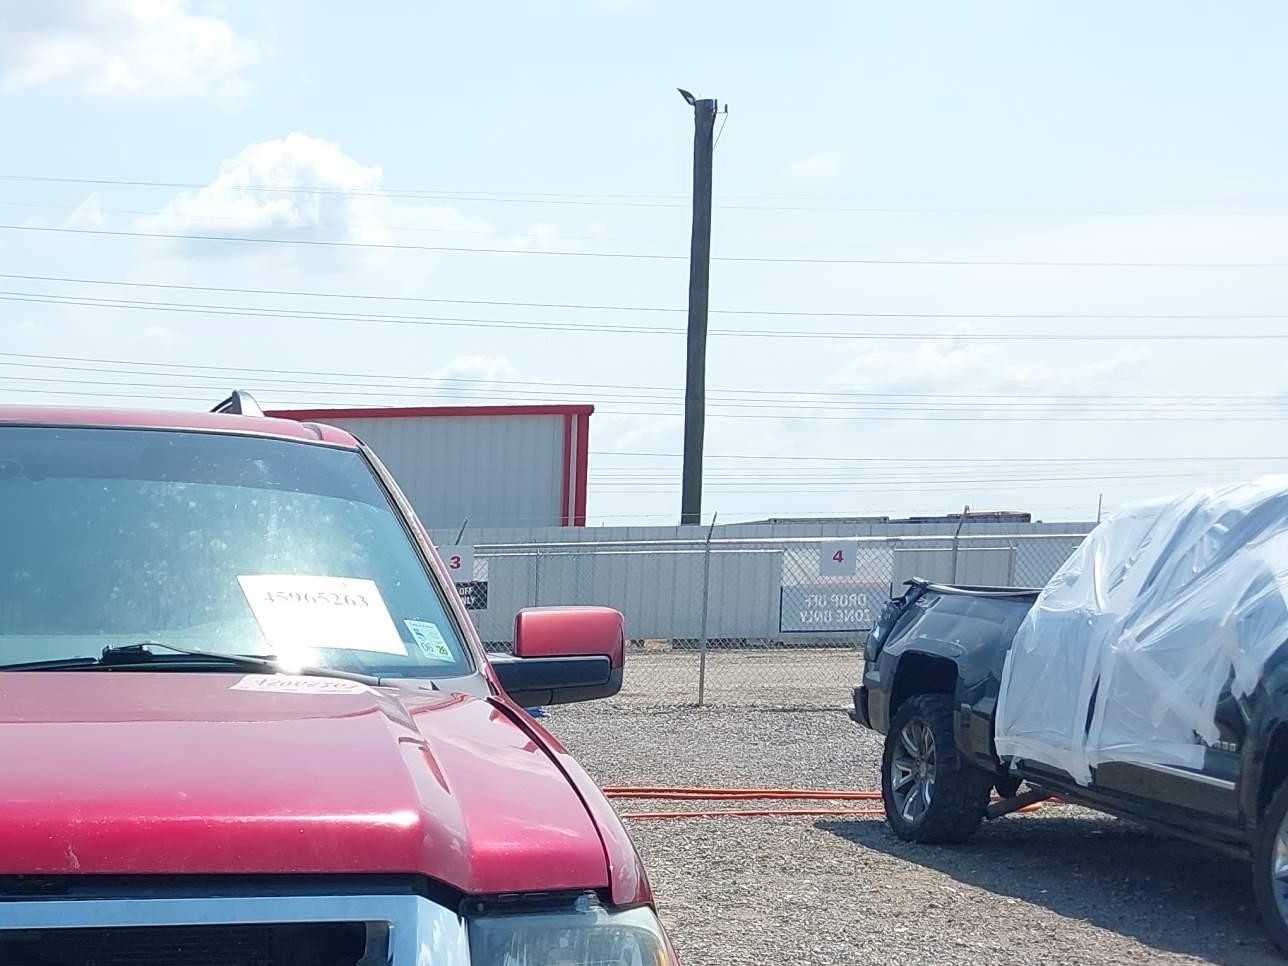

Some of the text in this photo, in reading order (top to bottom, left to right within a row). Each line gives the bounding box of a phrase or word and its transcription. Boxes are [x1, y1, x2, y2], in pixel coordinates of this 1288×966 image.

[450, 556, 461, 569] 3
[833, 550, 844, 563] 4
[459, 587, 473, 596] OFF
[264, 591, 369, 608] 45965263
